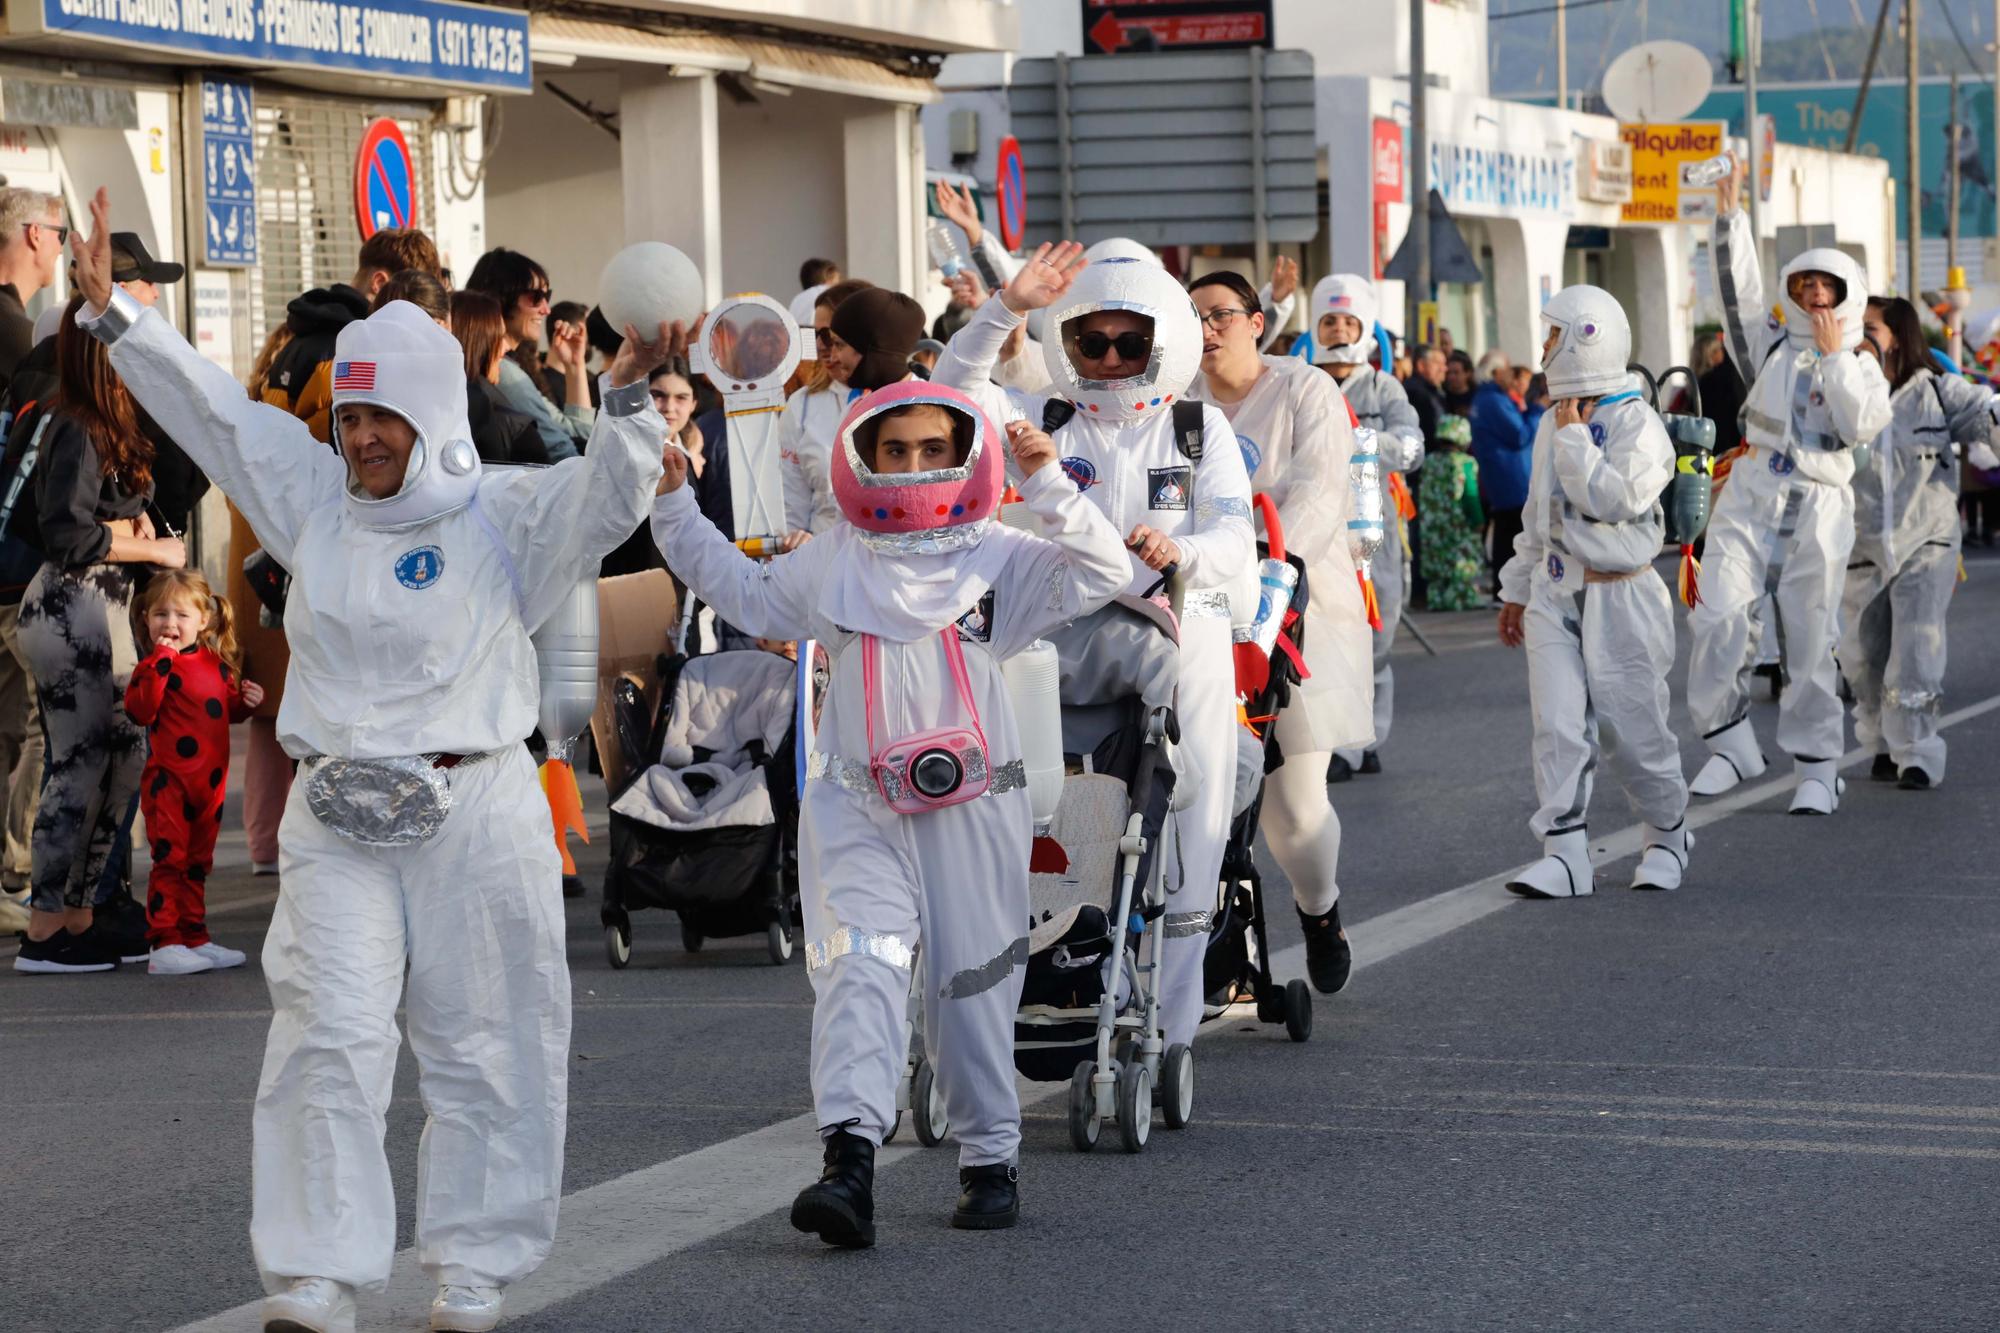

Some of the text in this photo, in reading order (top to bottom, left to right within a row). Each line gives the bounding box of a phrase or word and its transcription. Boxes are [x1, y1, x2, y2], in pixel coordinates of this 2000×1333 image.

[340, 5, 362, 55] DE
[363, 8, 432, 63] CONDUCIR
[471, 24, 488, 69] 34
[489, 26, 507, 72] 25
[508, 29, 525, 74] 25
[1795, 102, 1851, 131] The
[1431, 142, 1559, 210] SUPERMERCADO
